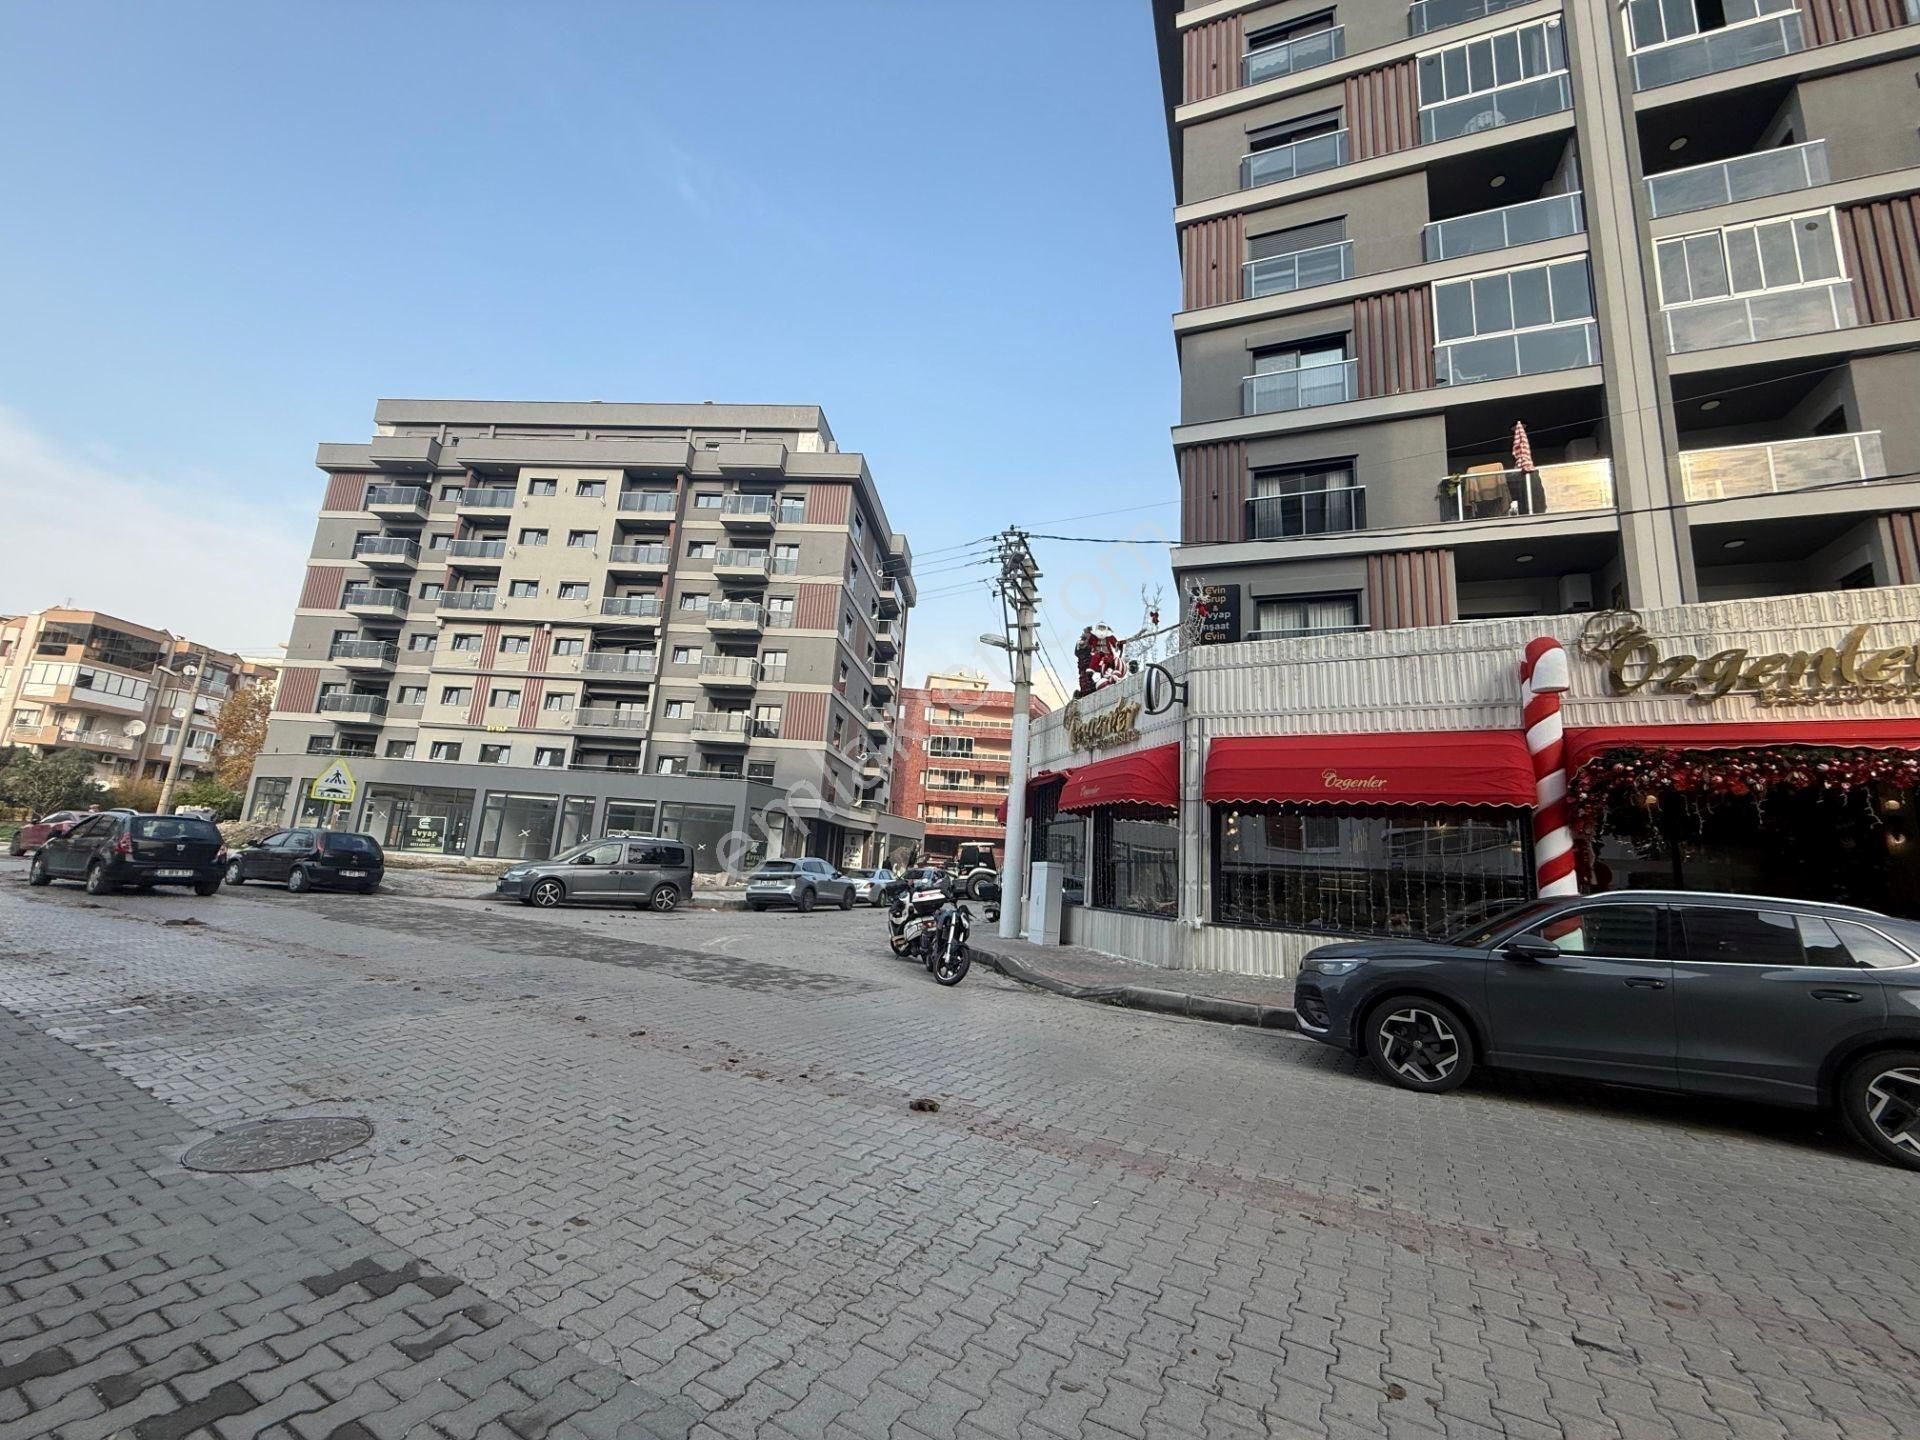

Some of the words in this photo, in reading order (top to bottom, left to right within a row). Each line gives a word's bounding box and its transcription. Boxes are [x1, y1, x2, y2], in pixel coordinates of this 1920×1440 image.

[1205, 611, 1231, 620] vyap
[1607, 622, 1920, 704] Özgenle
[411, 829, 437, 838] Evyap
